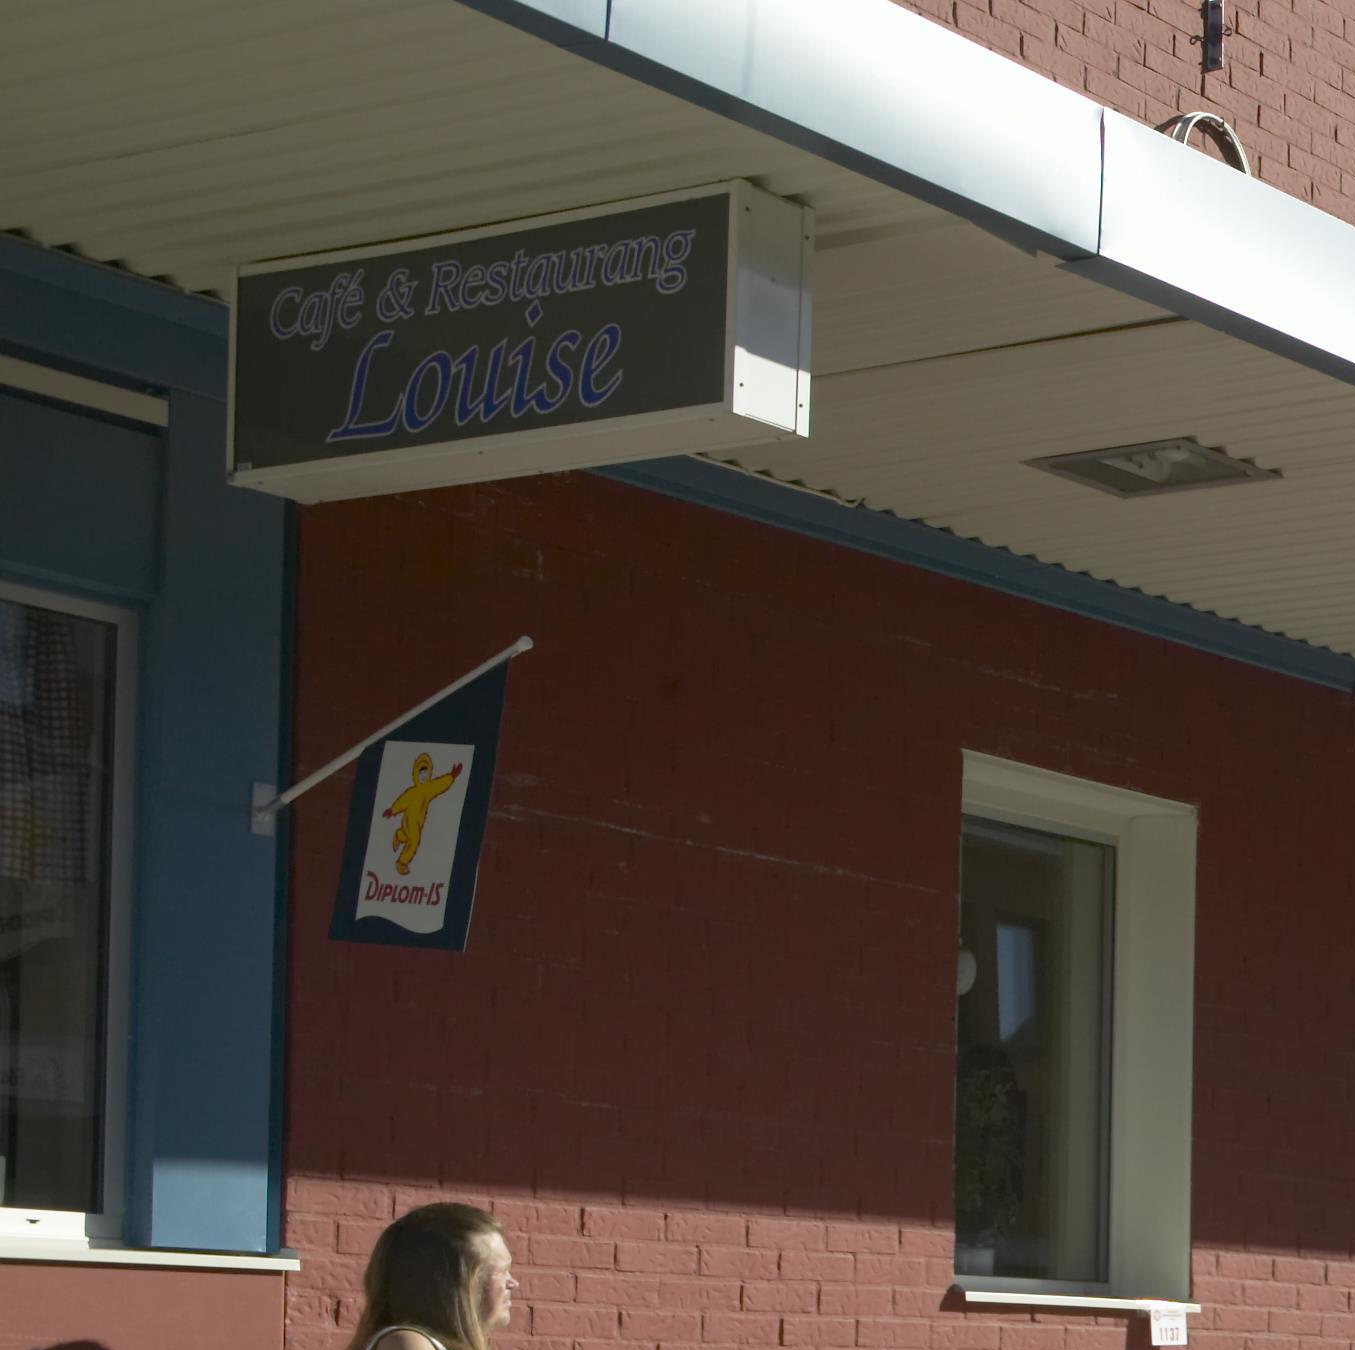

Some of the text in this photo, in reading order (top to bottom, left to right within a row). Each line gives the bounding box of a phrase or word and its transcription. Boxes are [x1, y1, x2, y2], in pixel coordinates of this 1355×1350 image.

[270, 228, 696, 350] Café & Restaurang
[326, 300, 623, 443] Louise
